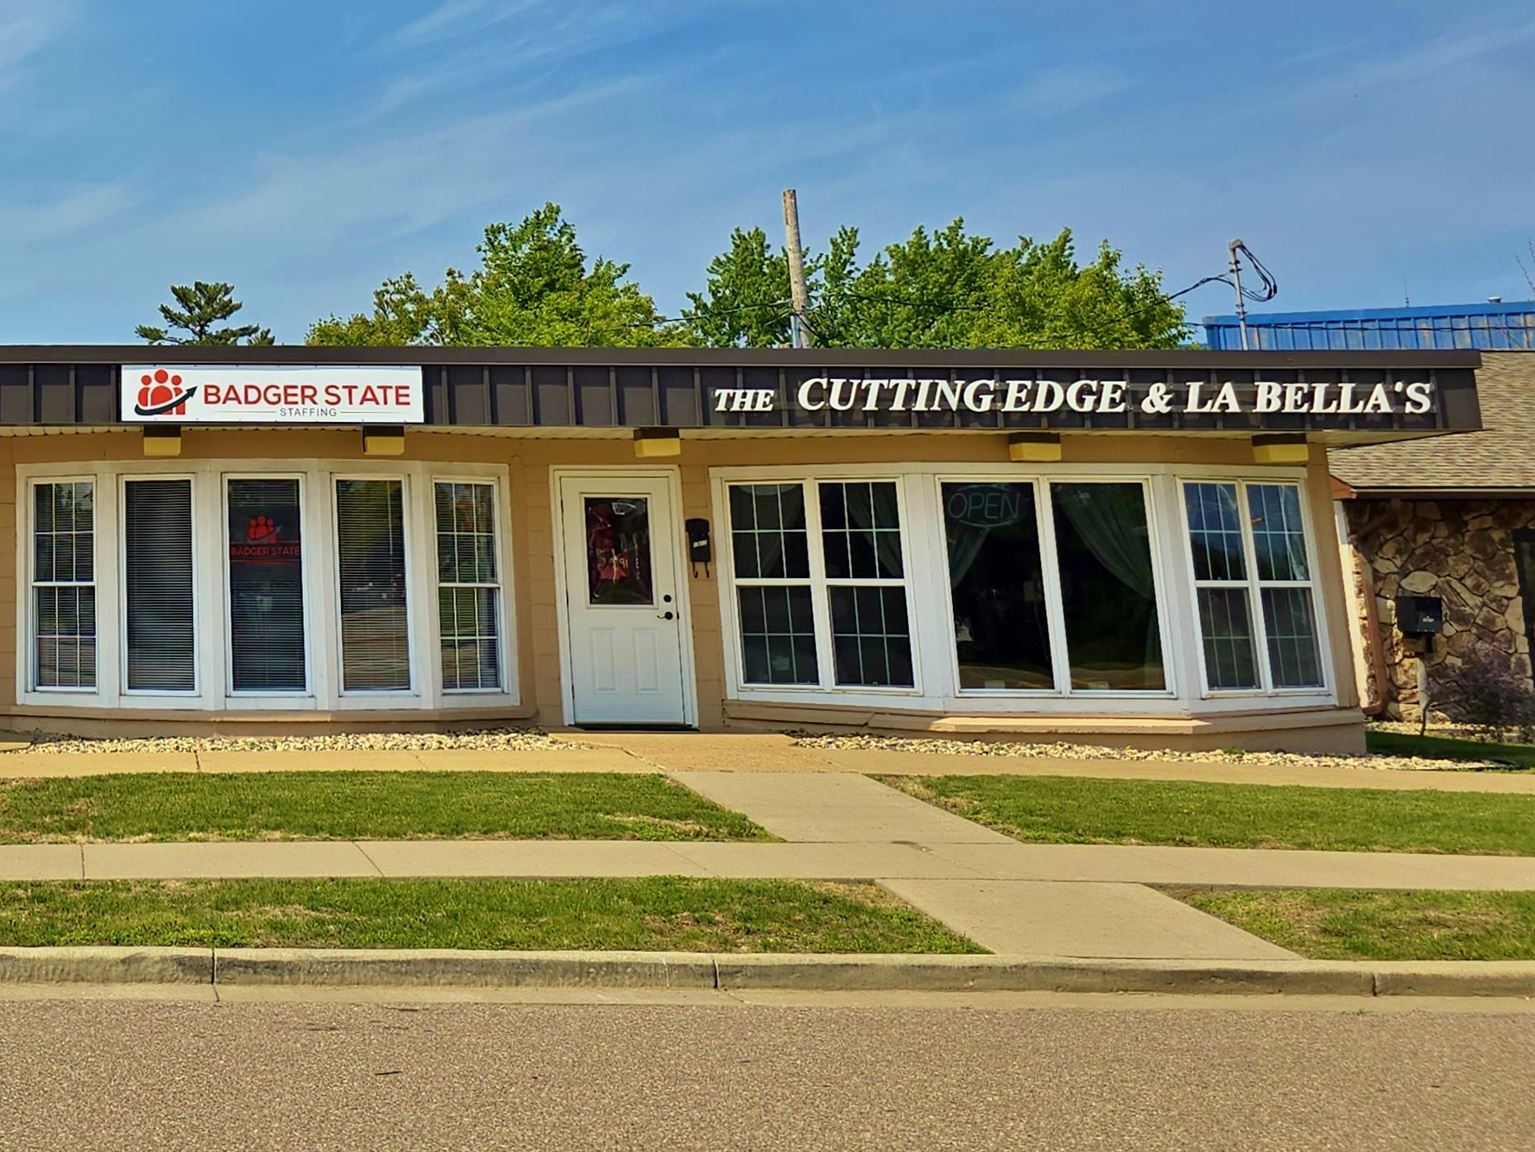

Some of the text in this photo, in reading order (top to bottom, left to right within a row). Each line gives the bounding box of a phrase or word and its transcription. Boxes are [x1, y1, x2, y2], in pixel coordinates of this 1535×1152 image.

[203, 384, 411, 406] BADGER STATE
[713, 388, 775, 412] THE
[1140, 382, 1174, 414] &
[1182, 381, 1242, 414] LA
[1251, 381, 1432, 415] BELLA'S
[279, 407, 338, 417] STAFFING
[948, 492, 1020, 519] OPEN
[230, 546, 300, 556] BADGER STATE
